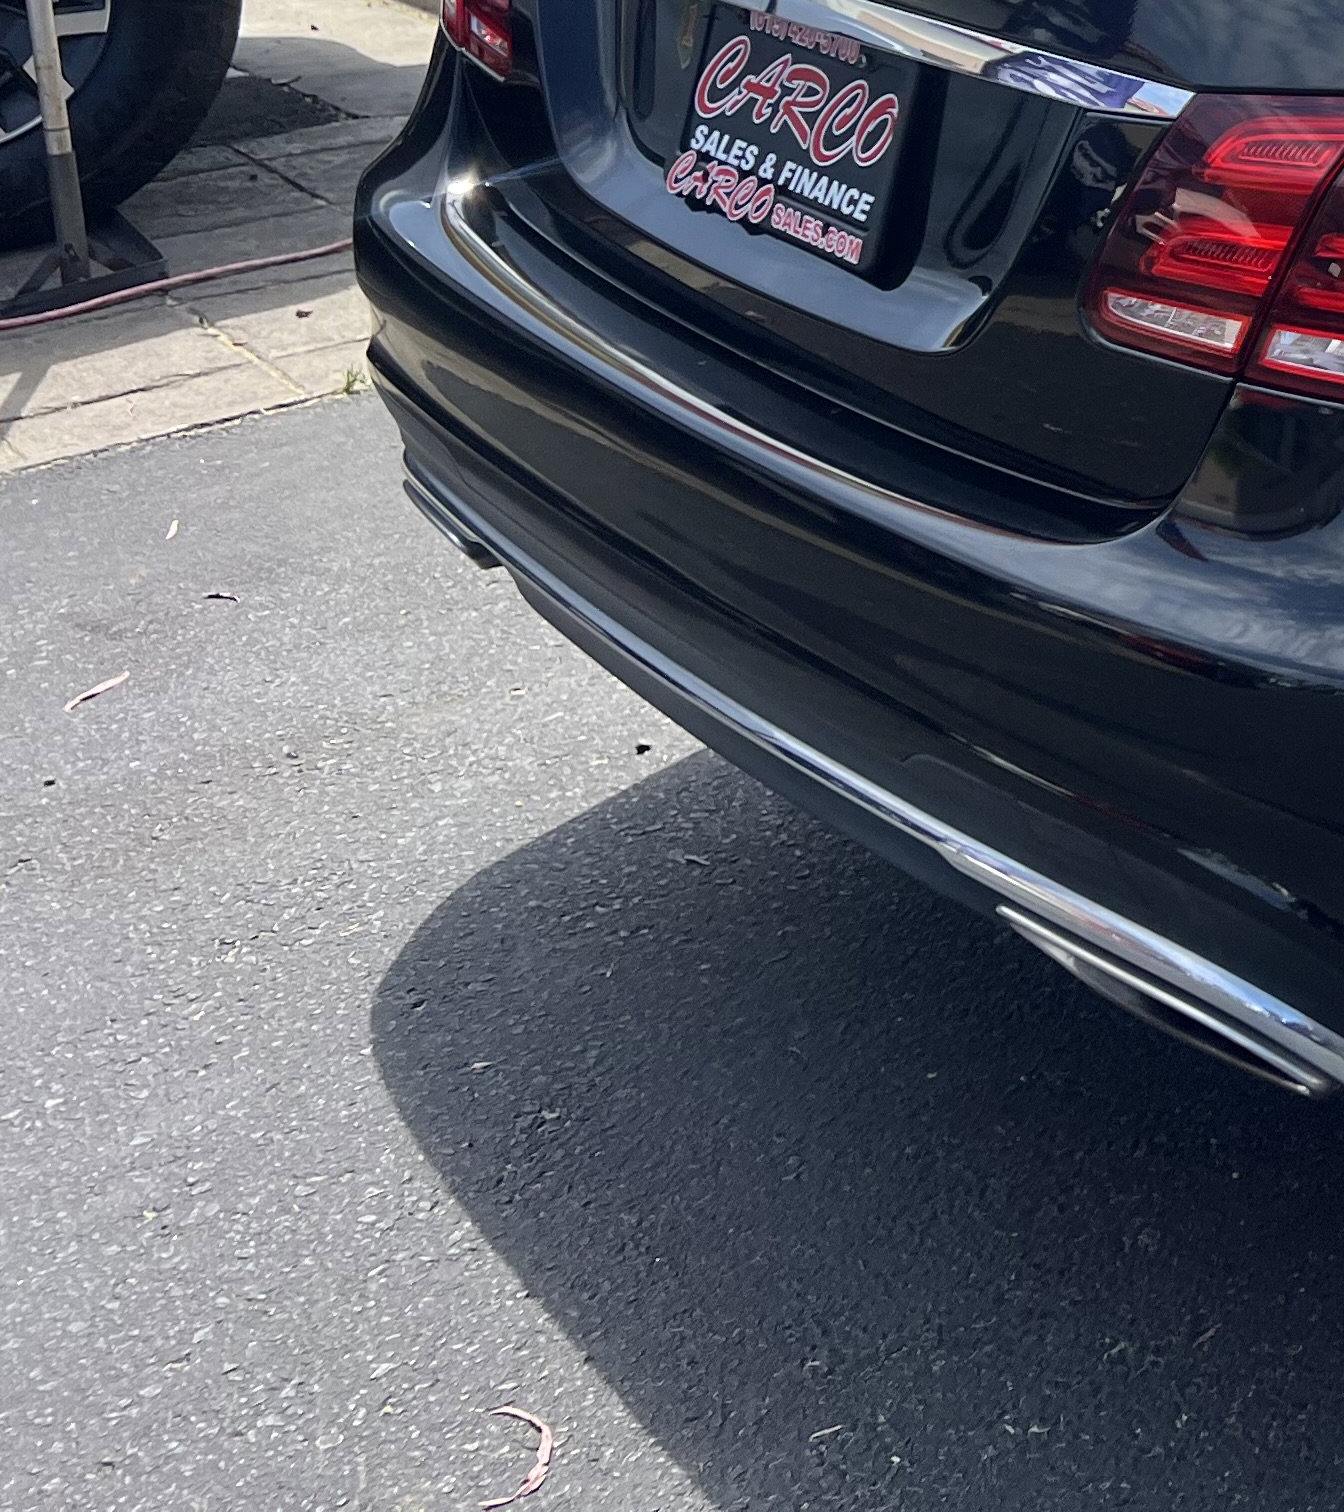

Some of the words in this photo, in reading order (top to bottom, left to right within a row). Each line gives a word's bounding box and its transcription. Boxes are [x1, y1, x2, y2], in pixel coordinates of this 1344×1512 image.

[695, 35, 899, 167] CARCO
[666, 150, 775, 223] CARCO
[690, 125, 760, 170] SALES
[758, 153, 777, 180] &
[778, 160, 875, 222] FINANCE
